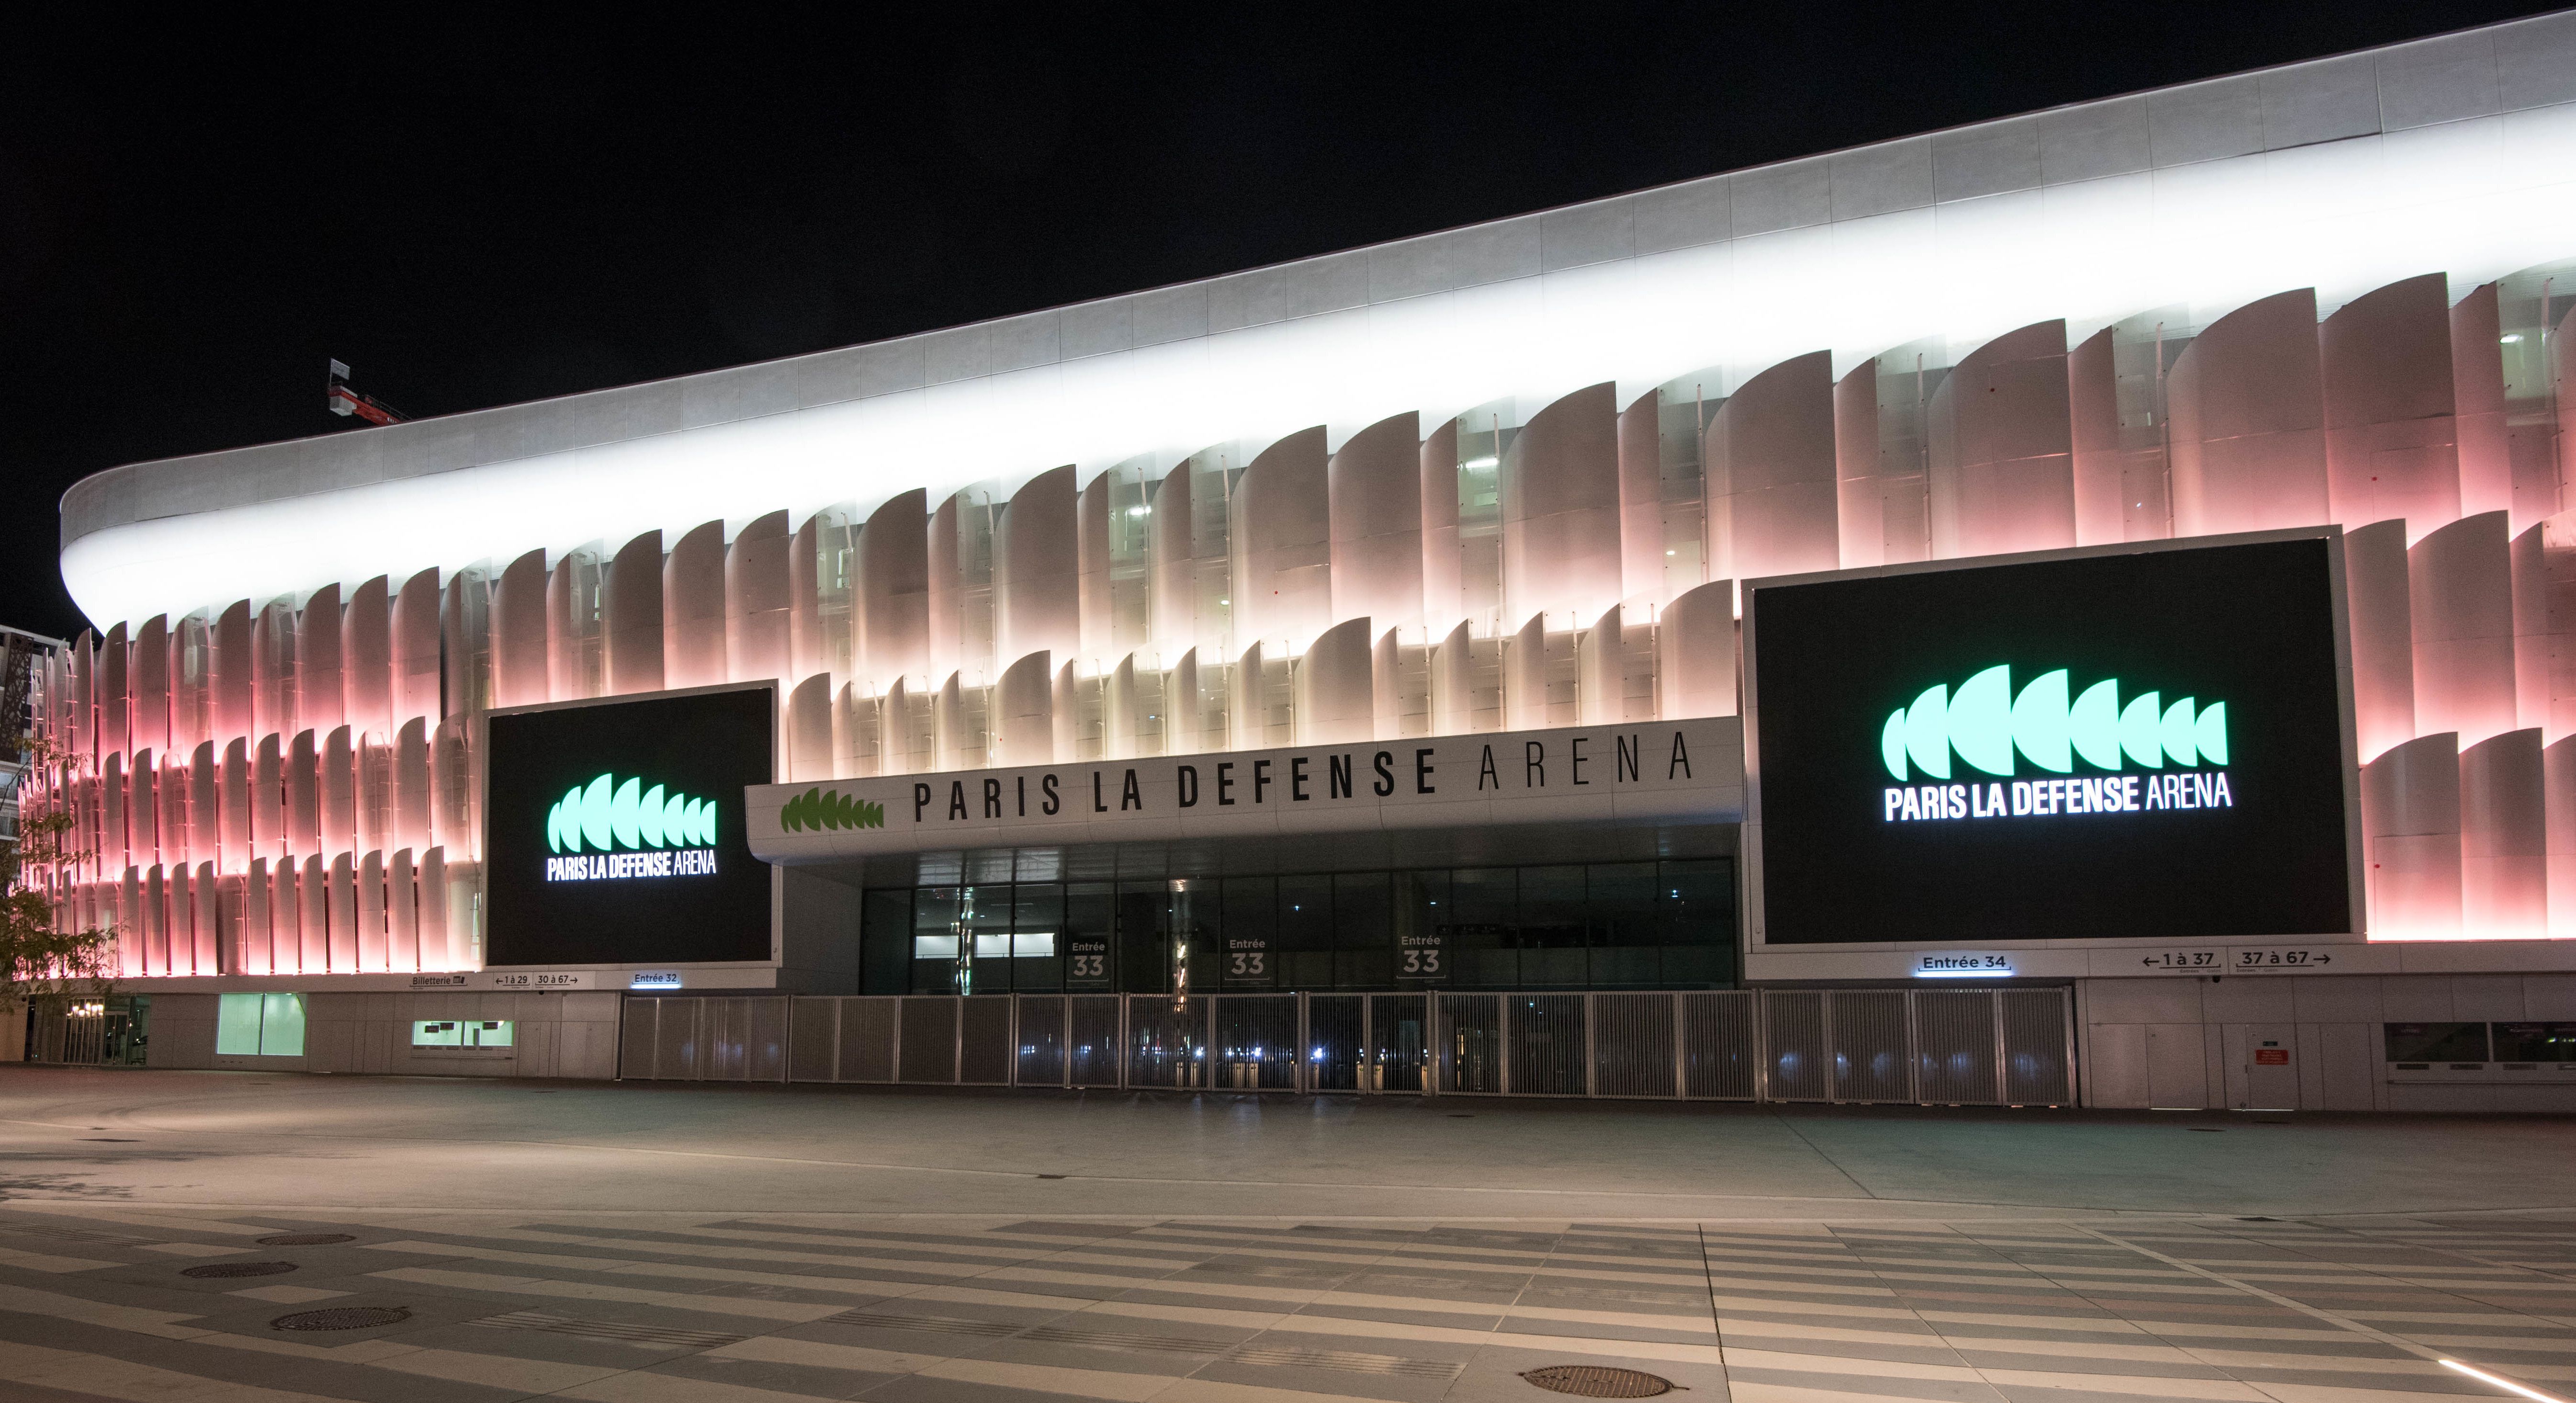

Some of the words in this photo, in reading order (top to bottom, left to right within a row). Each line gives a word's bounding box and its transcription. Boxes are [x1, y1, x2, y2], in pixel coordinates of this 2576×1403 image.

[915, 774, 1060, 822] PARIS
[1094, 769, 1142, 812] LA
[1177, 748, 1435, 808] DEFENSE
[1478, 731, 1692, 791] ARENA
[1885, 784, 1967, 822] PARIS
[1971, 782, 2007, 818] LA
[2011, 775, 2139, 816] DEFENSE
[2145, 772, 2232, 810] ARENA
[547, 855, 588, 882] PARIS
[589, 855, 607, 880] LA
[609, 851, 671, 879] DEFENSE
[673, 849, 716, 876] ARENA
[1072, 942, 1105, 951] Entrée
[1230, 939, 1265, 948] Entrée
[1401, 935, 1441, 945] Entrée
[1231, 952, 1264, 974] 33
[1403, 950, 1439, 973] 33
[1923, 956, 1979, 969] Entrée
[1985, 956, 2006, 967] 34
[2163, 953, 2170, 965] 1
[2177, 952, 2187, 965] à
[2193, 952, 2214, 965] 37
[2242, 951, 2263, 964] 37
[2270, 950, 2280, 964] à
[2286, 951, 2309, 964] 67
[1073, 955, 1103, 976] 33
[412, 976, 451, 985] Billetterie
[505, 975, 508, 984] 1
[510, 975, 515, 984] à
[517, 975, 528, 984] 29
[538, 975, 549, 984] 30
[551, 974, 556, 984] à
[558, 975, 569, 984] 67
[634, 973, 663, 982] Entrée
[666, 973, 677, 982] 32
